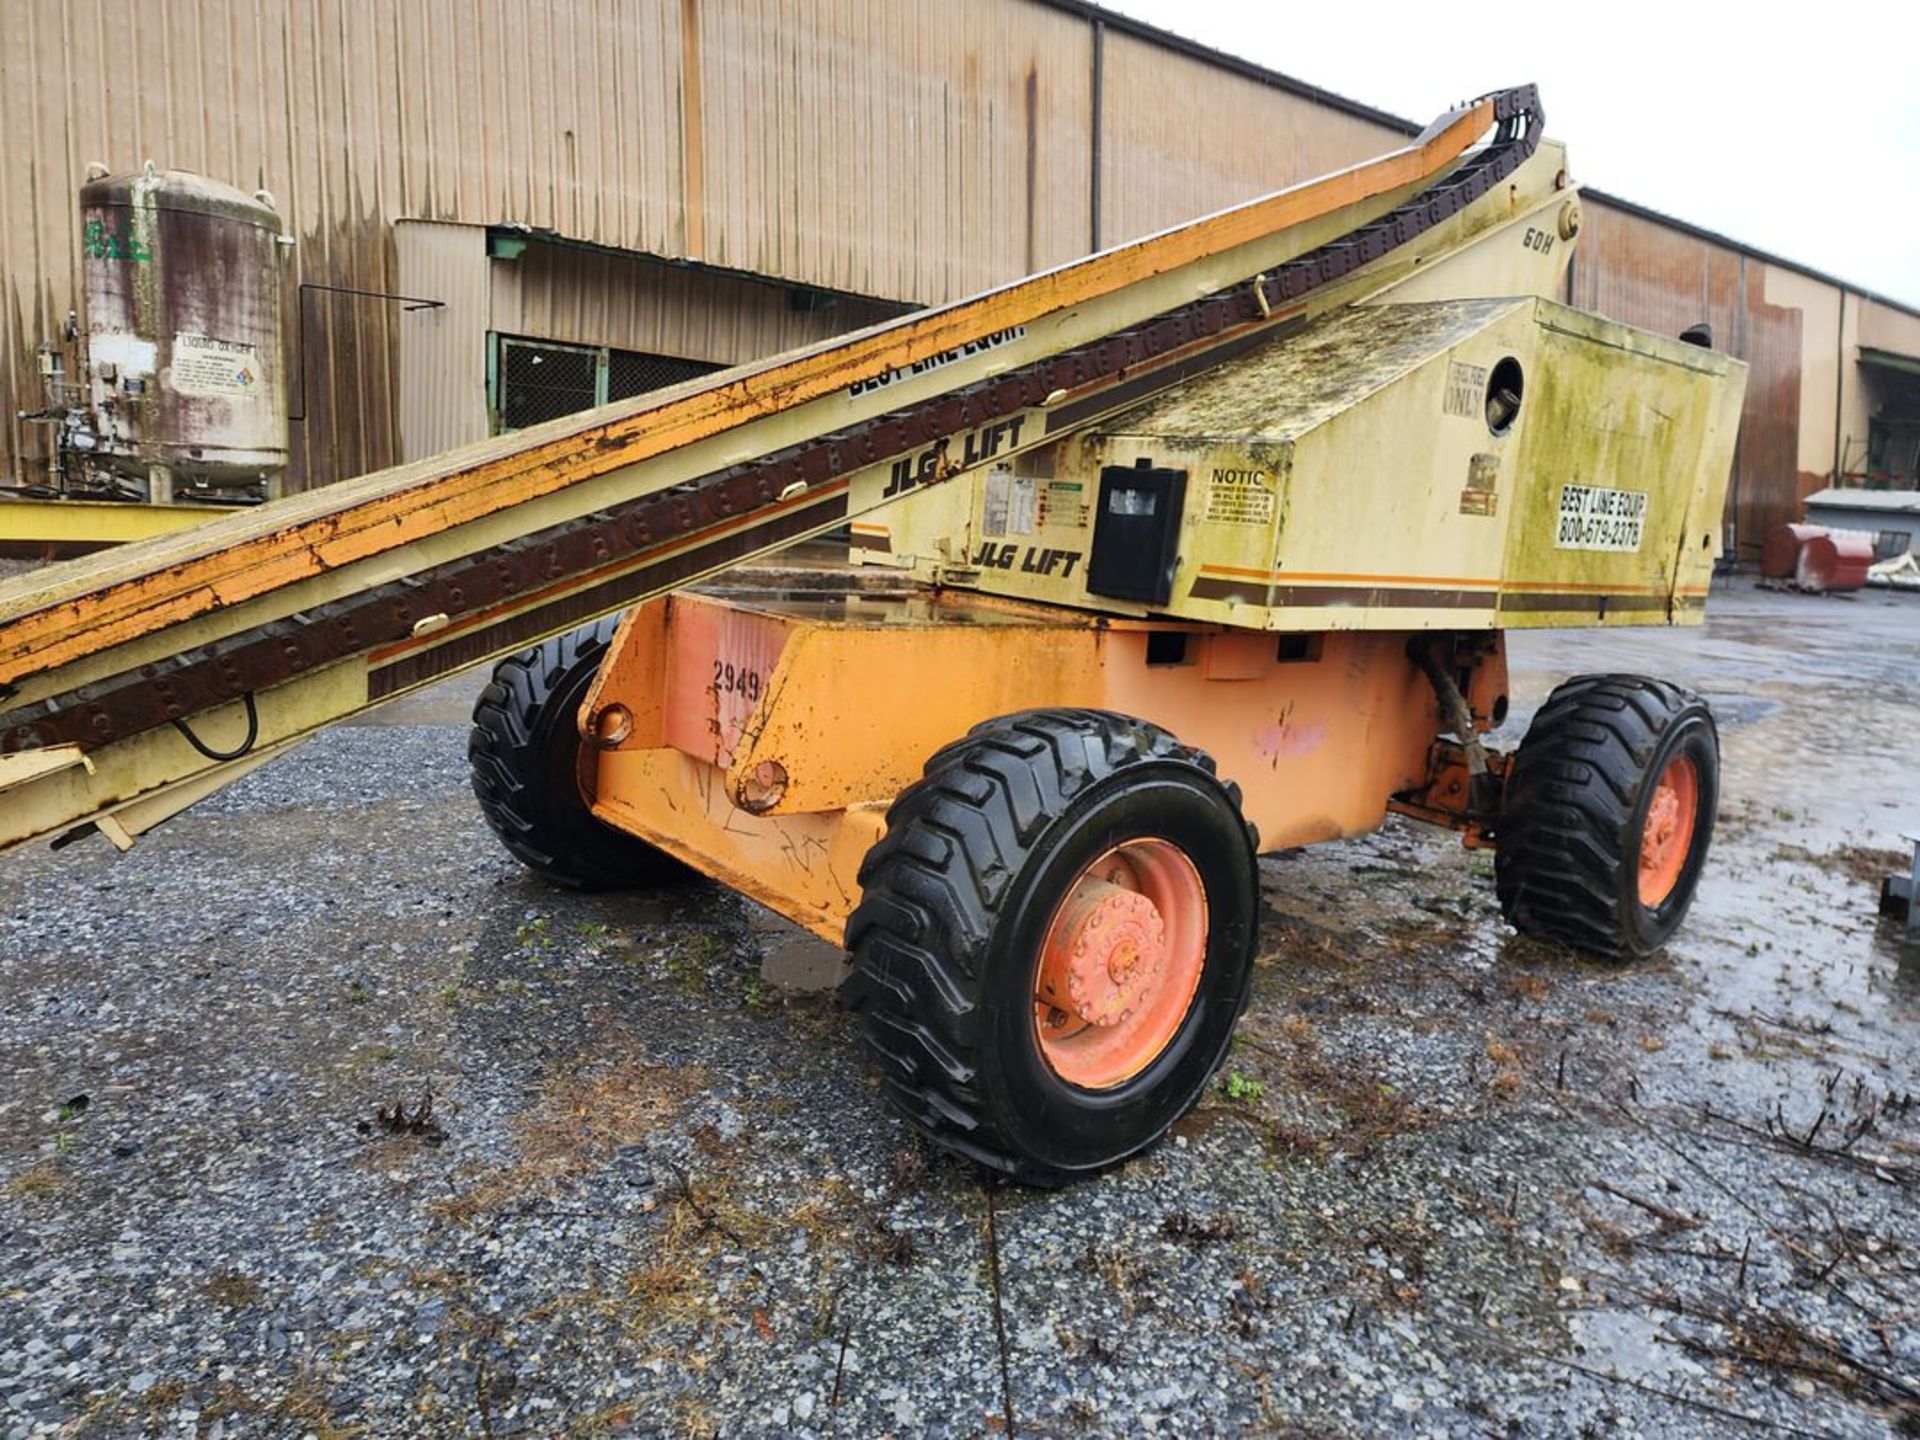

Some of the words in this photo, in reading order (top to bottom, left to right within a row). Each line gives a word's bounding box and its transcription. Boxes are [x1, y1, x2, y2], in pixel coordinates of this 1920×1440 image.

[1522, 227, 1555, 255] 60H
[883, 444, 941, 498] JLG
[964, 414, 1026, 465] LIFT
[1211, 468, 1265, 485] NOTIC
[1561, 485, 1590, 512] BEST
[1590, 489, 1616, 516] LINE
[971, 542, 1019, 570] JLG
[1021, 547, 1083, 578] LIFT
[713, 660, 759, 703] 2949
